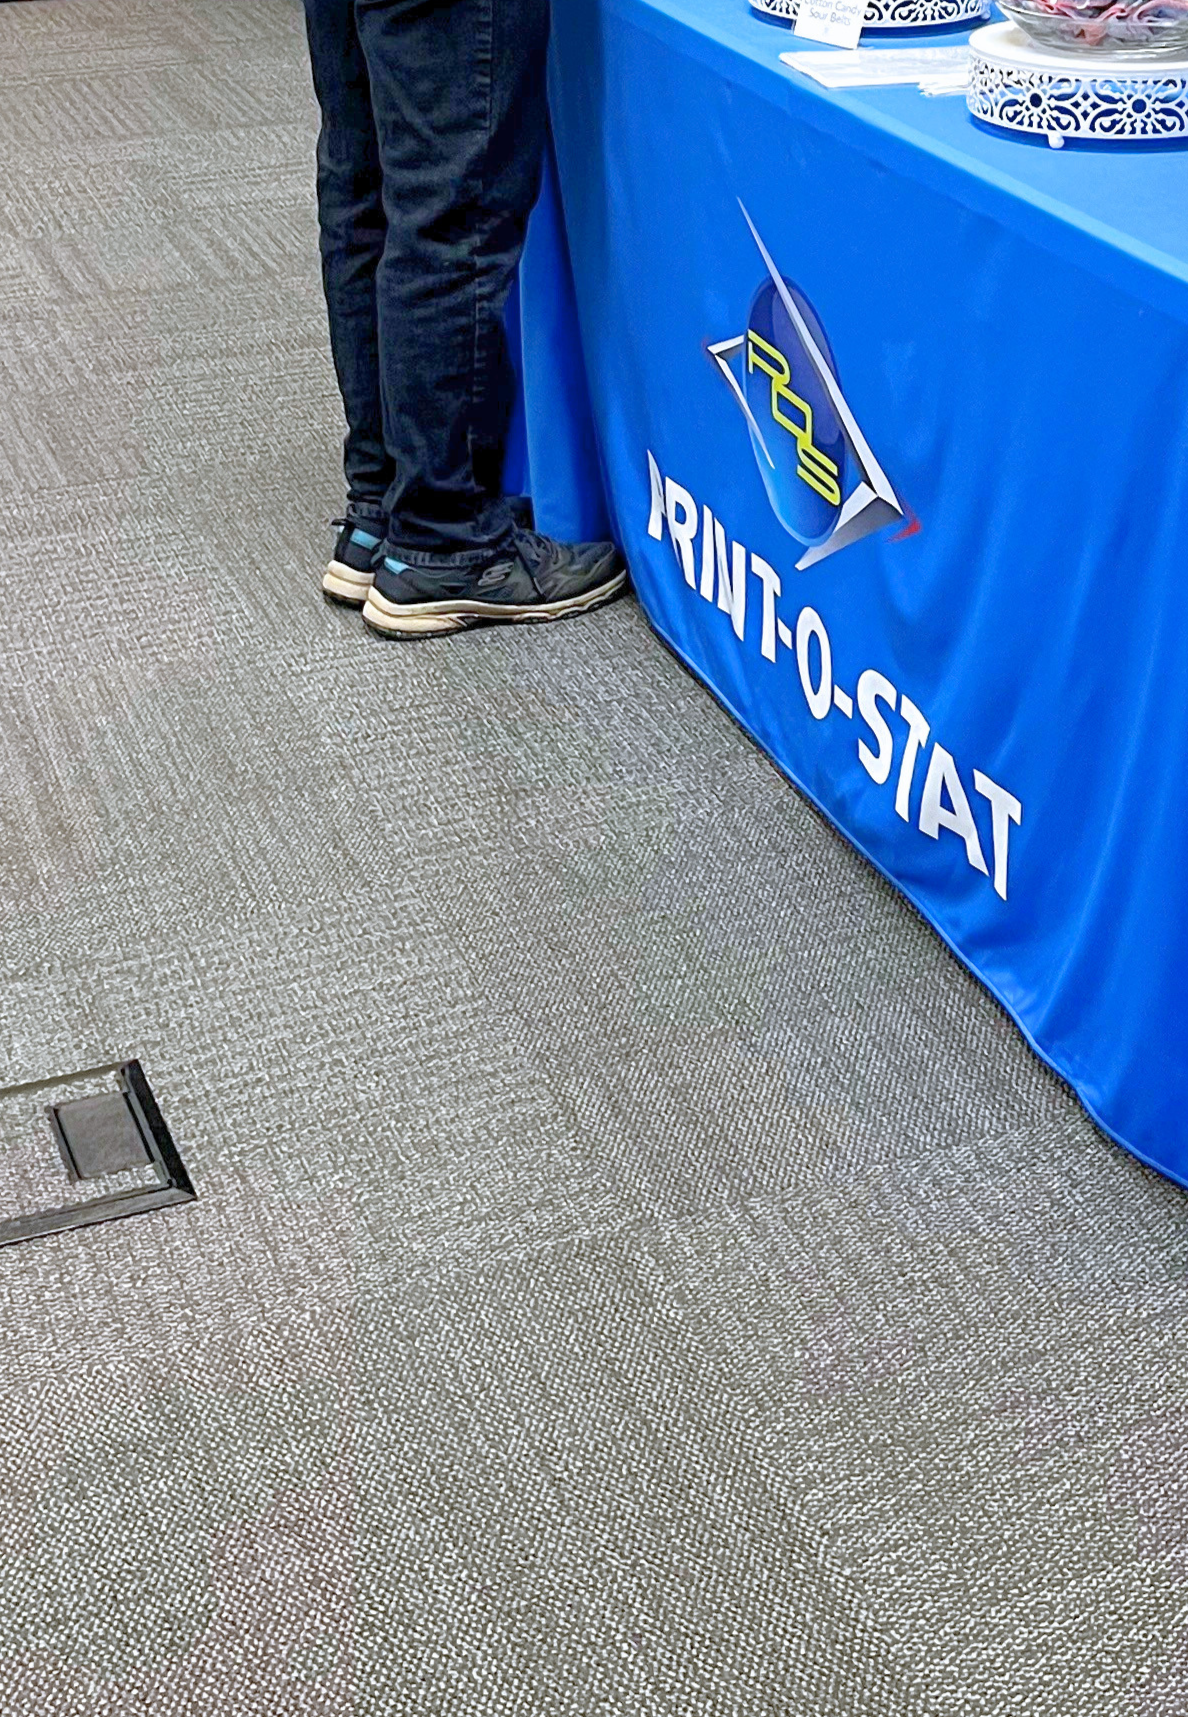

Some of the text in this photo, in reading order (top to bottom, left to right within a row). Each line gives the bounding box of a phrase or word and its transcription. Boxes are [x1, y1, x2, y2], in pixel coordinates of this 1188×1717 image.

[809, 7, 828, 20] Sour
[835, 0, 862, 17] Candy
[747, 328, 842, 507] POS
